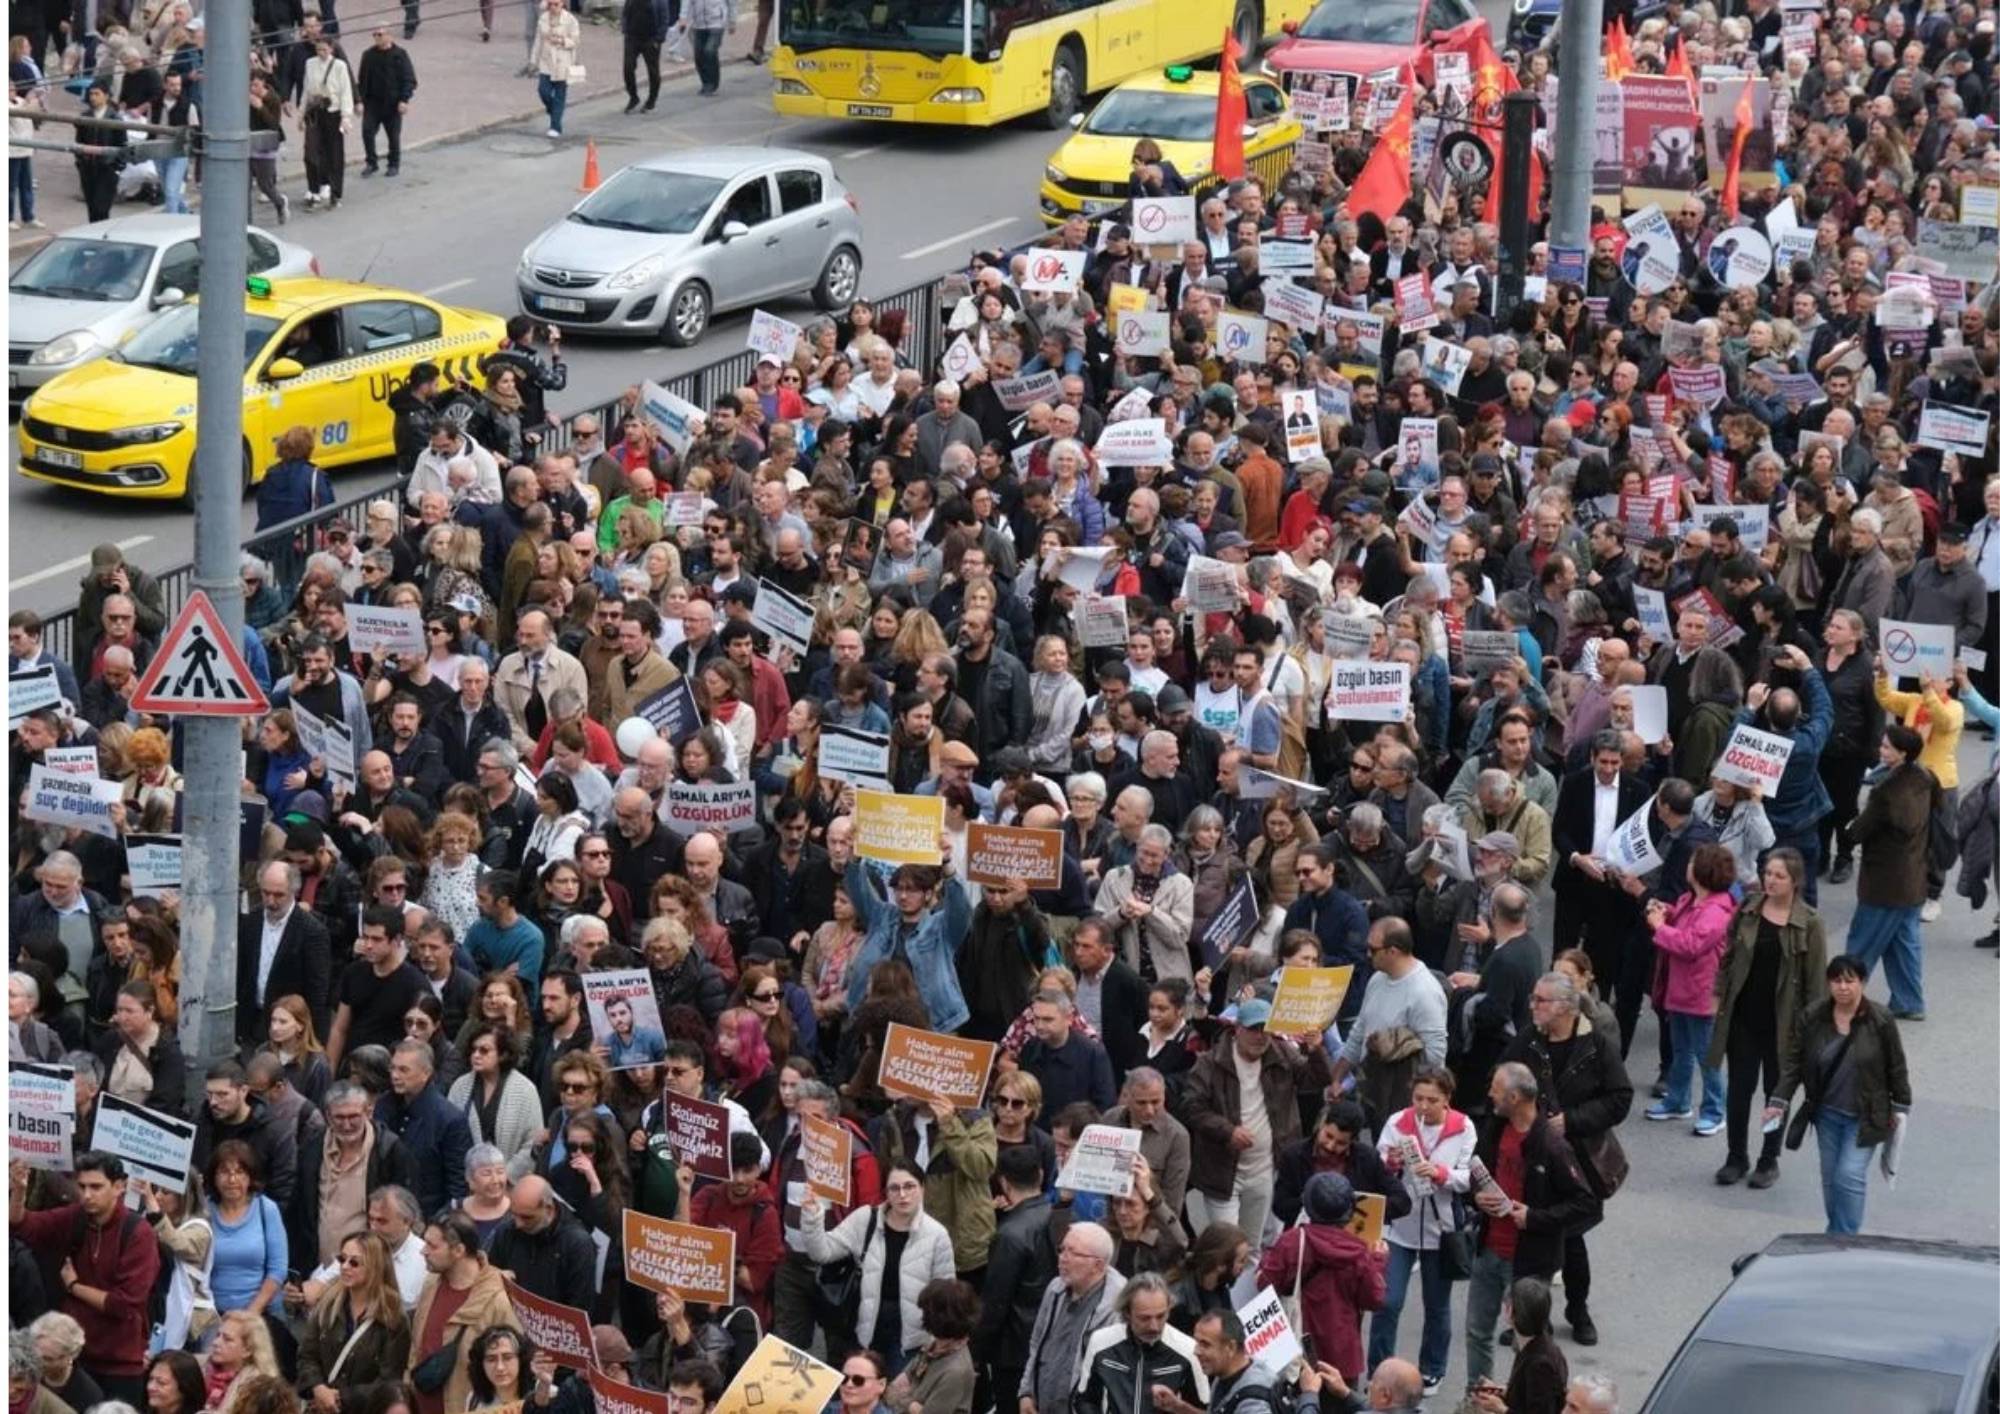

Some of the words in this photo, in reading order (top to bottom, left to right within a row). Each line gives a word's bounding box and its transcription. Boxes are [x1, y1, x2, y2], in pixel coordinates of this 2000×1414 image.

[321, 421, 348, 446] 80
[1336, 669, 1366, 690] özgür
[1369, 668, 1401, 686] basın
[1203, 708, 1237, 726] tgs
[1724, 746, 1783, 778] ÖZGÜRLÜK
[41, 776, 93, 795] gazetecilik
[669, 788, 709, 803] İSMAİL
[713, 788, 751, 803] ARI'YA
[36, 791, 58, 810] suç
[671, 803, 754, 822] ÖZGÜRLÜK
[586, 978, 616, 989] İSMAİL
[618, 976, 647, 987] ARI'YA
[944, 1046, 974, 1061] alma
[18, 1111, 61, 1137] basın
[120, 1116, 137, 1132] Bu
[670, 1101, 720, 1131] Sözümüz
[641, 1224, 678, 1244] Haber
[680, 1233, 714, 1250] alma
[629, 1246, 723, 1278] GELECEĞİMİZİ
[629, 1259, 726, 1292] KAZANACAĞIZ
